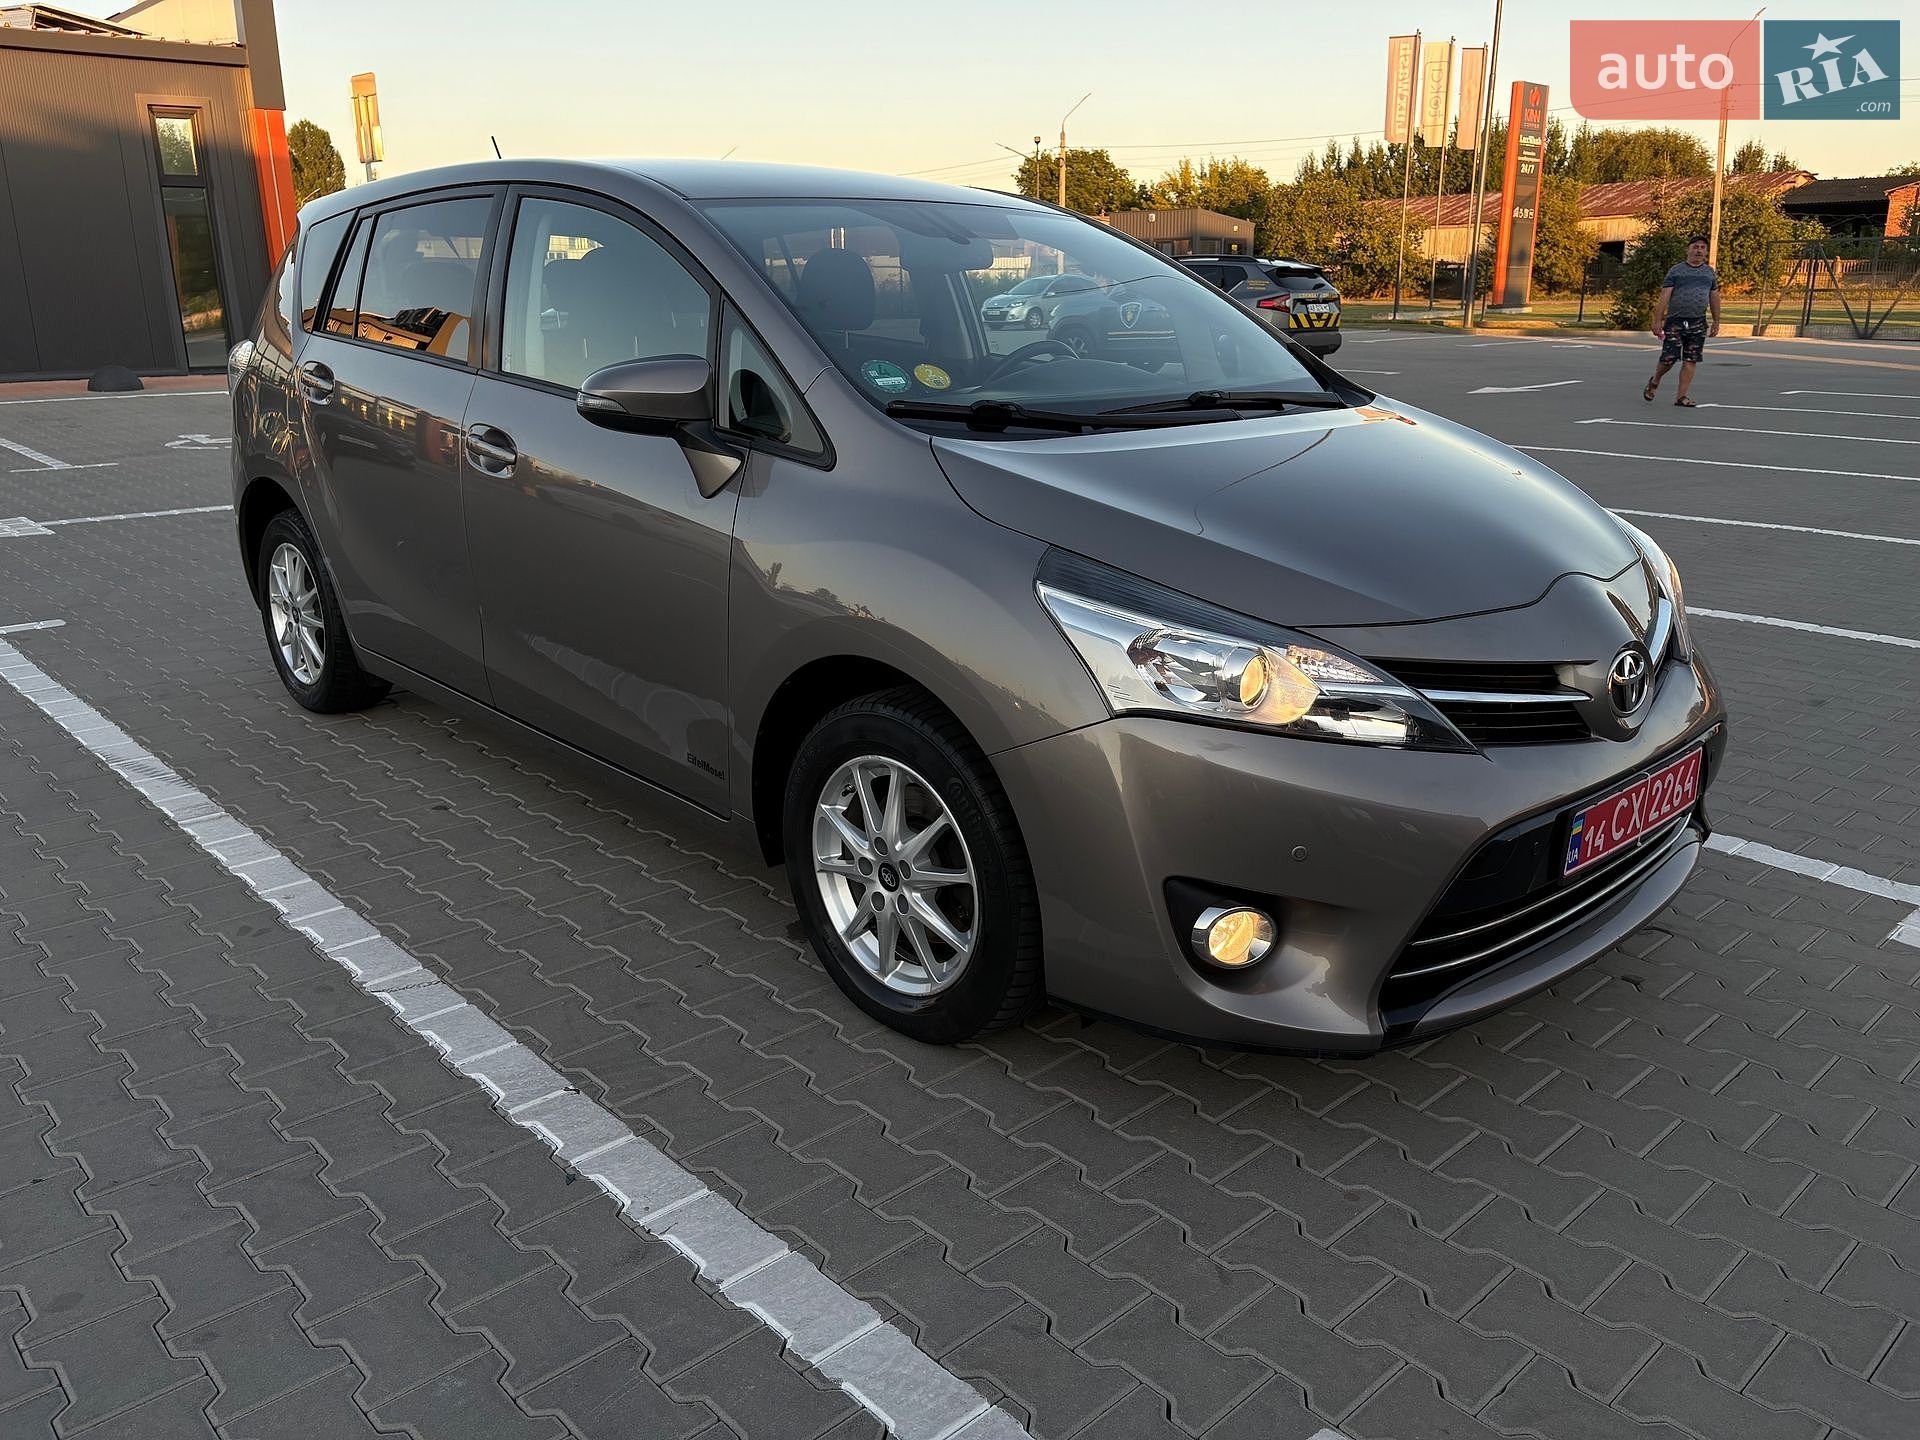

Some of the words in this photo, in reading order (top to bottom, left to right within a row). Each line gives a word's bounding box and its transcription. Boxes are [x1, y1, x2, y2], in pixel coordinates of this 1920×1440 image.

[1584, 820, 1606, 857] 14
[1611, 787, 1645, 841] CX
[1649, 760, 1696, 822] 2264
[1567, 848, 1579, 863] UA
